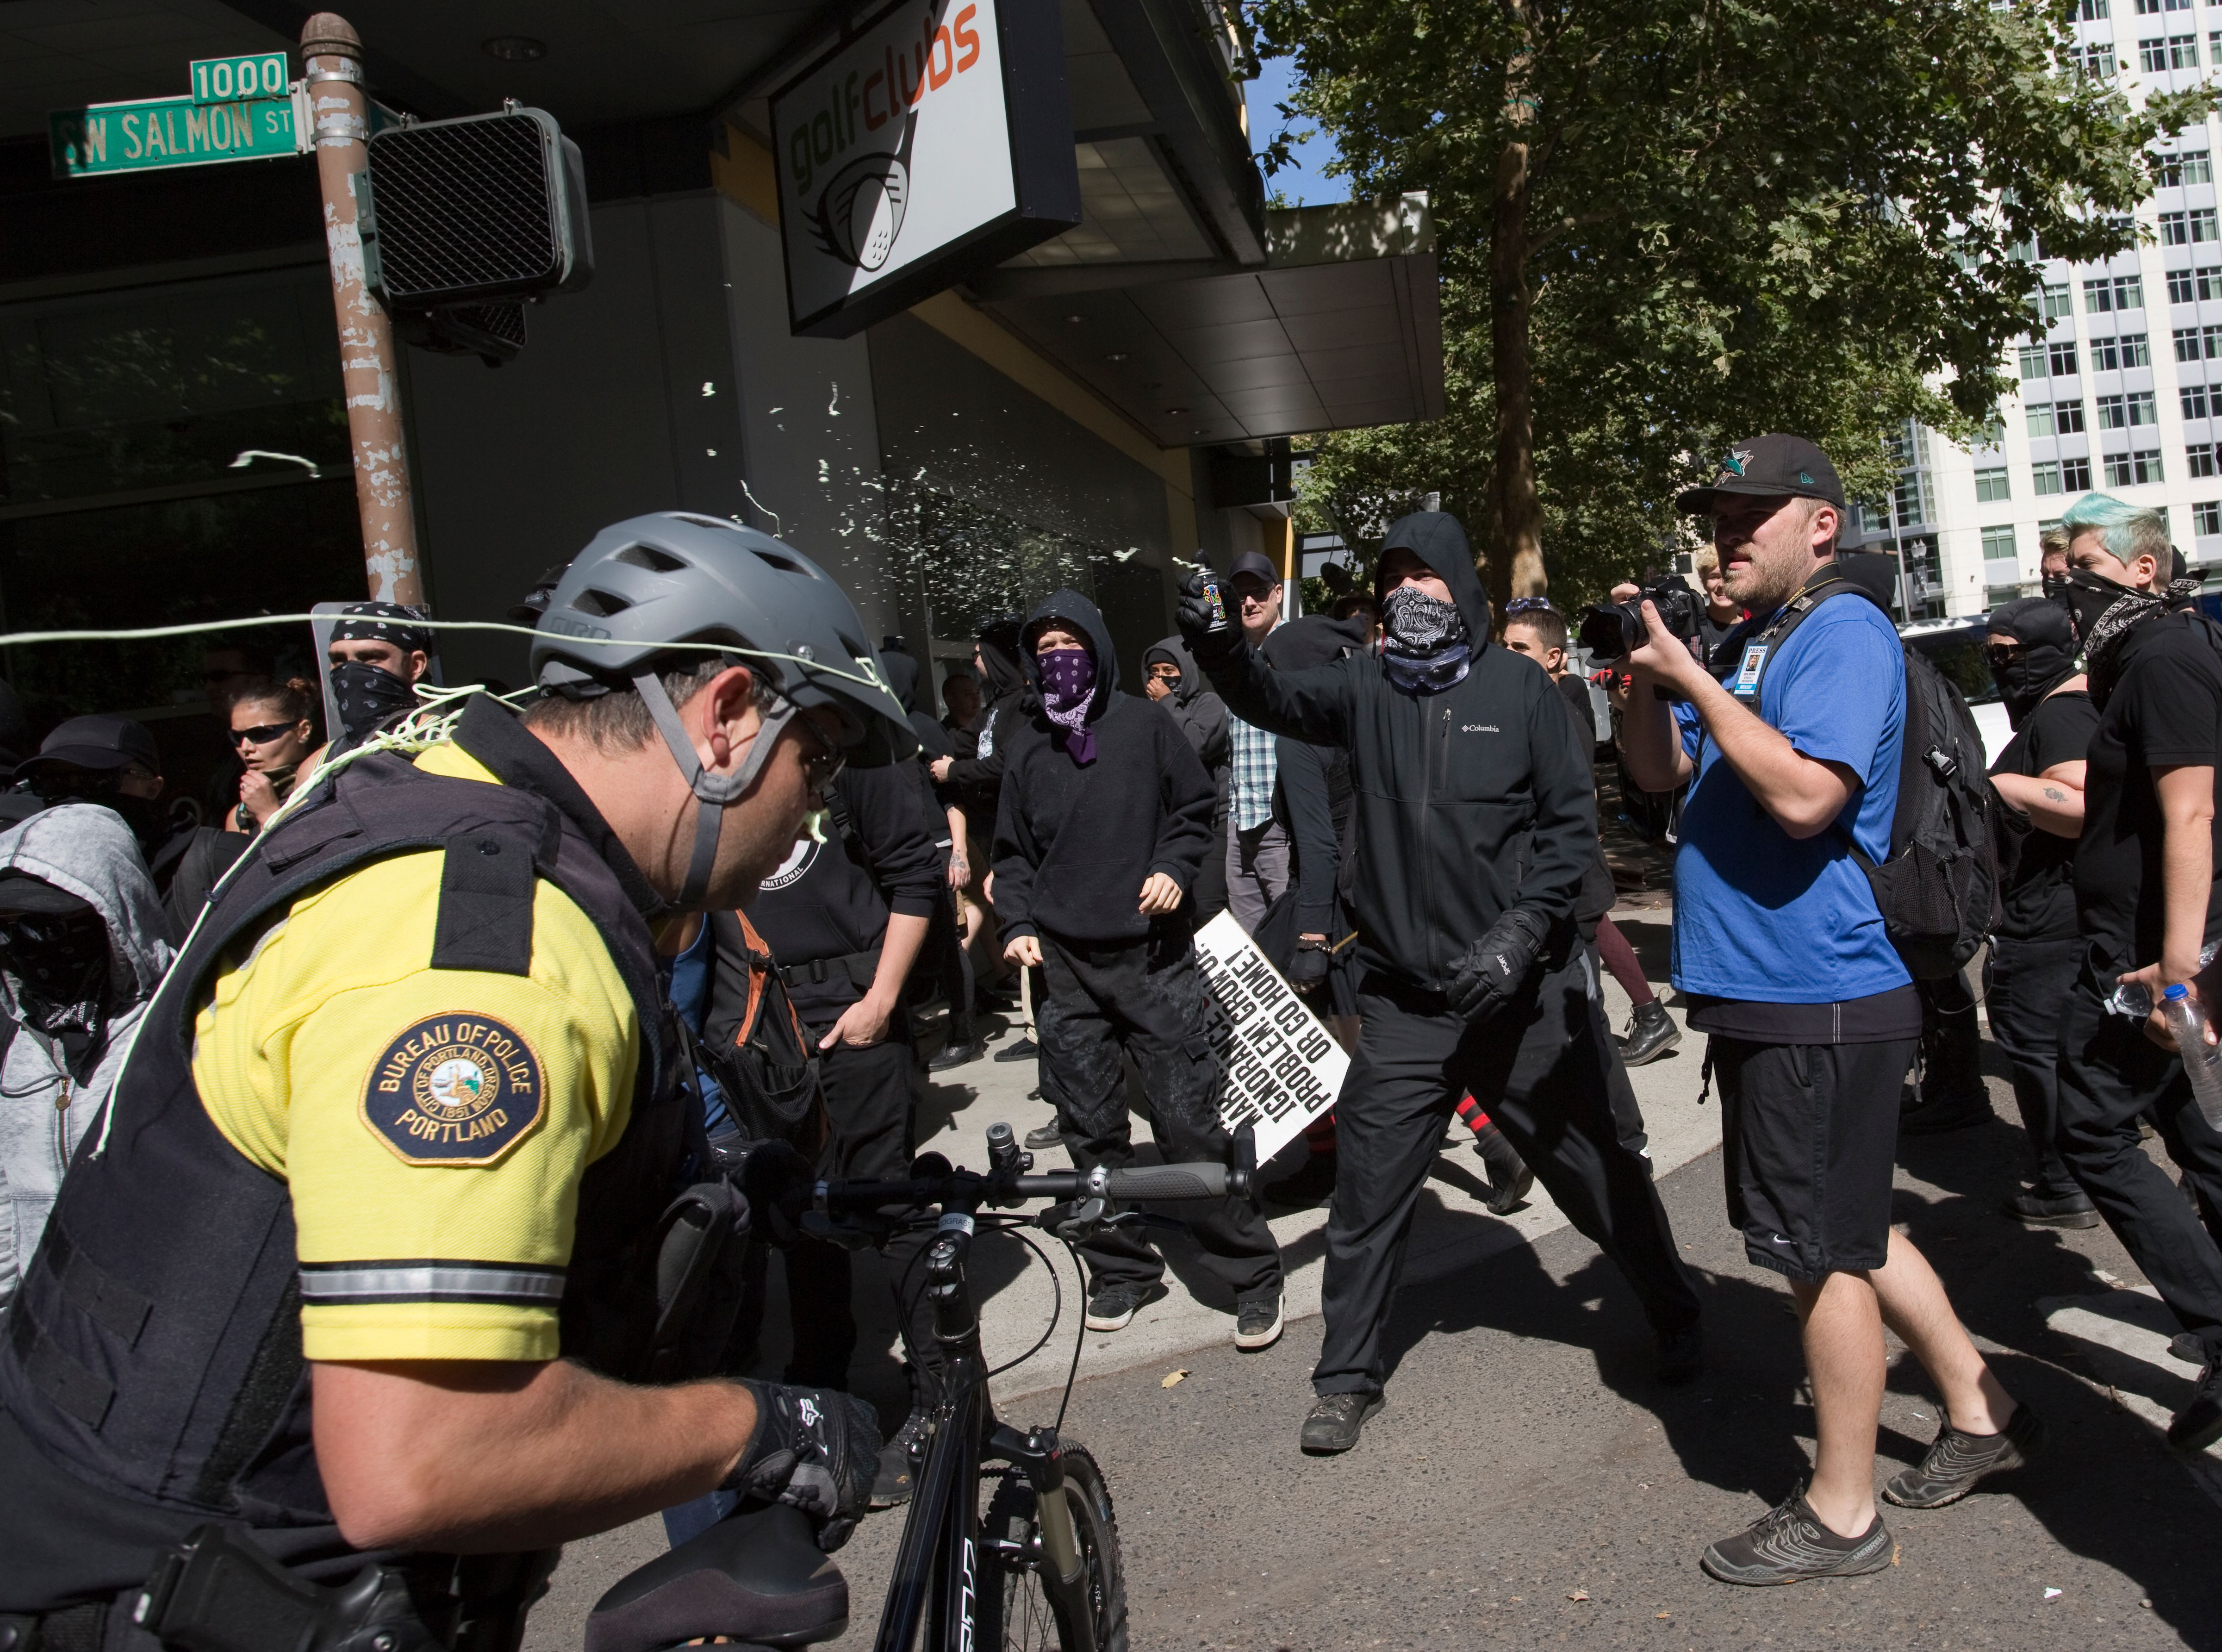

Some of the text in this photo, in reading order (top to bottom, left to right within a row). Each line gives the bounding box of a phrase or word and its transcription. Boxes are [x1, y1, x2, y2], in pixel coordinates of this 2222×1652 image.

[197, 58, 282, 99] 1000
[59, 103, 291, 165] SW SALMON ST
[1469, 724, 1500, 733] Columbia
[760, 867, 803, 887] RNATIONAL
[1496, 954, 1510, 975] SPORT
[1202, 969, 1257, 1025] GROW
[1224, 944, 1331, 1064] OR GO HOME!
[378, 1022, 533, 1095] BUREAU OF POLICE
[1204, 1011, 1297, 1123] IGNORANCE
[1241, 1016, 1331, 1114] PROBLEM!
[417, 1072, 430, 1088] OF
[470, 1067, 496, 1112] OREGON
[417, 1091, 441, 1112] CITY
[440, 1105, 470, 1118] 1851
[394, 1108, 509, 1143] PORTLAND
